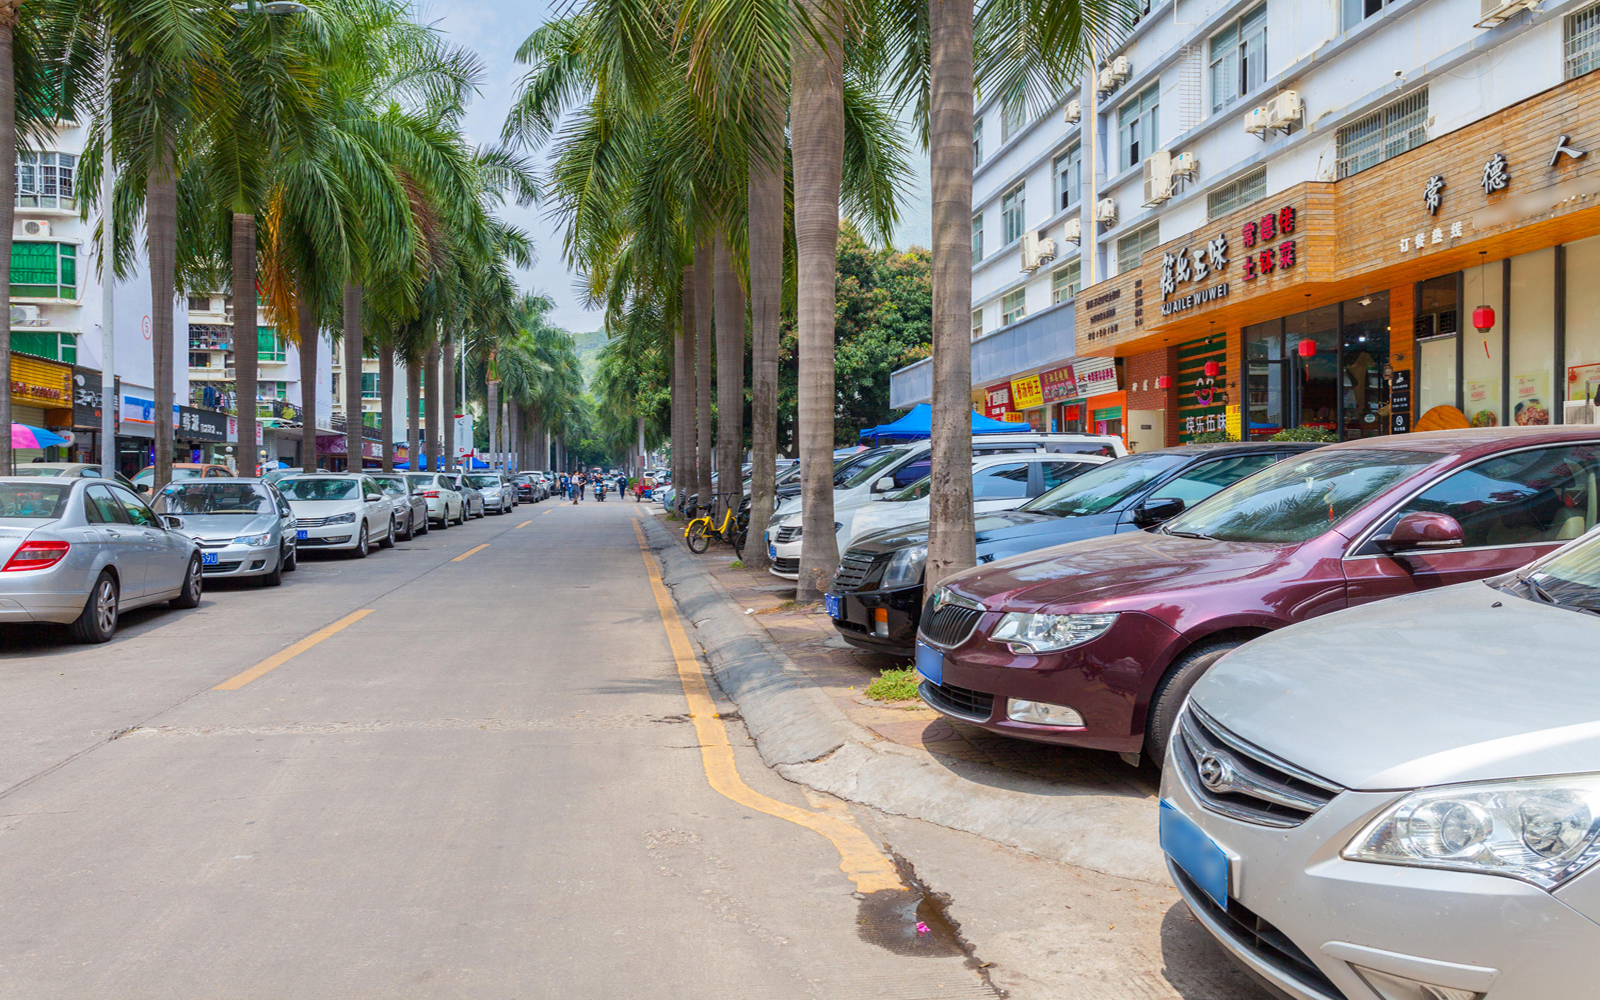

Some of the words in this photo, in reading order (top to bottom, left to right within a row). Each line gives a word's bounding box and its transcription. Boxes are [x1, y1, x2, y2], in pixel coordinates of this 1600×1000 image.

[1423, 135, 1587, 216] 常德人
[1242, 206, 1295, 247] 常德佬
[1399, 221, 1462, 252] 订餐热线
[1242, 240, 1295, 282] 土钵菜
[1161, 295, 1194, 316] KUAILE
[1194, 283, 1229, 306] WUWEI
[1186, 412, 1226, 434] 筷乐伍味
